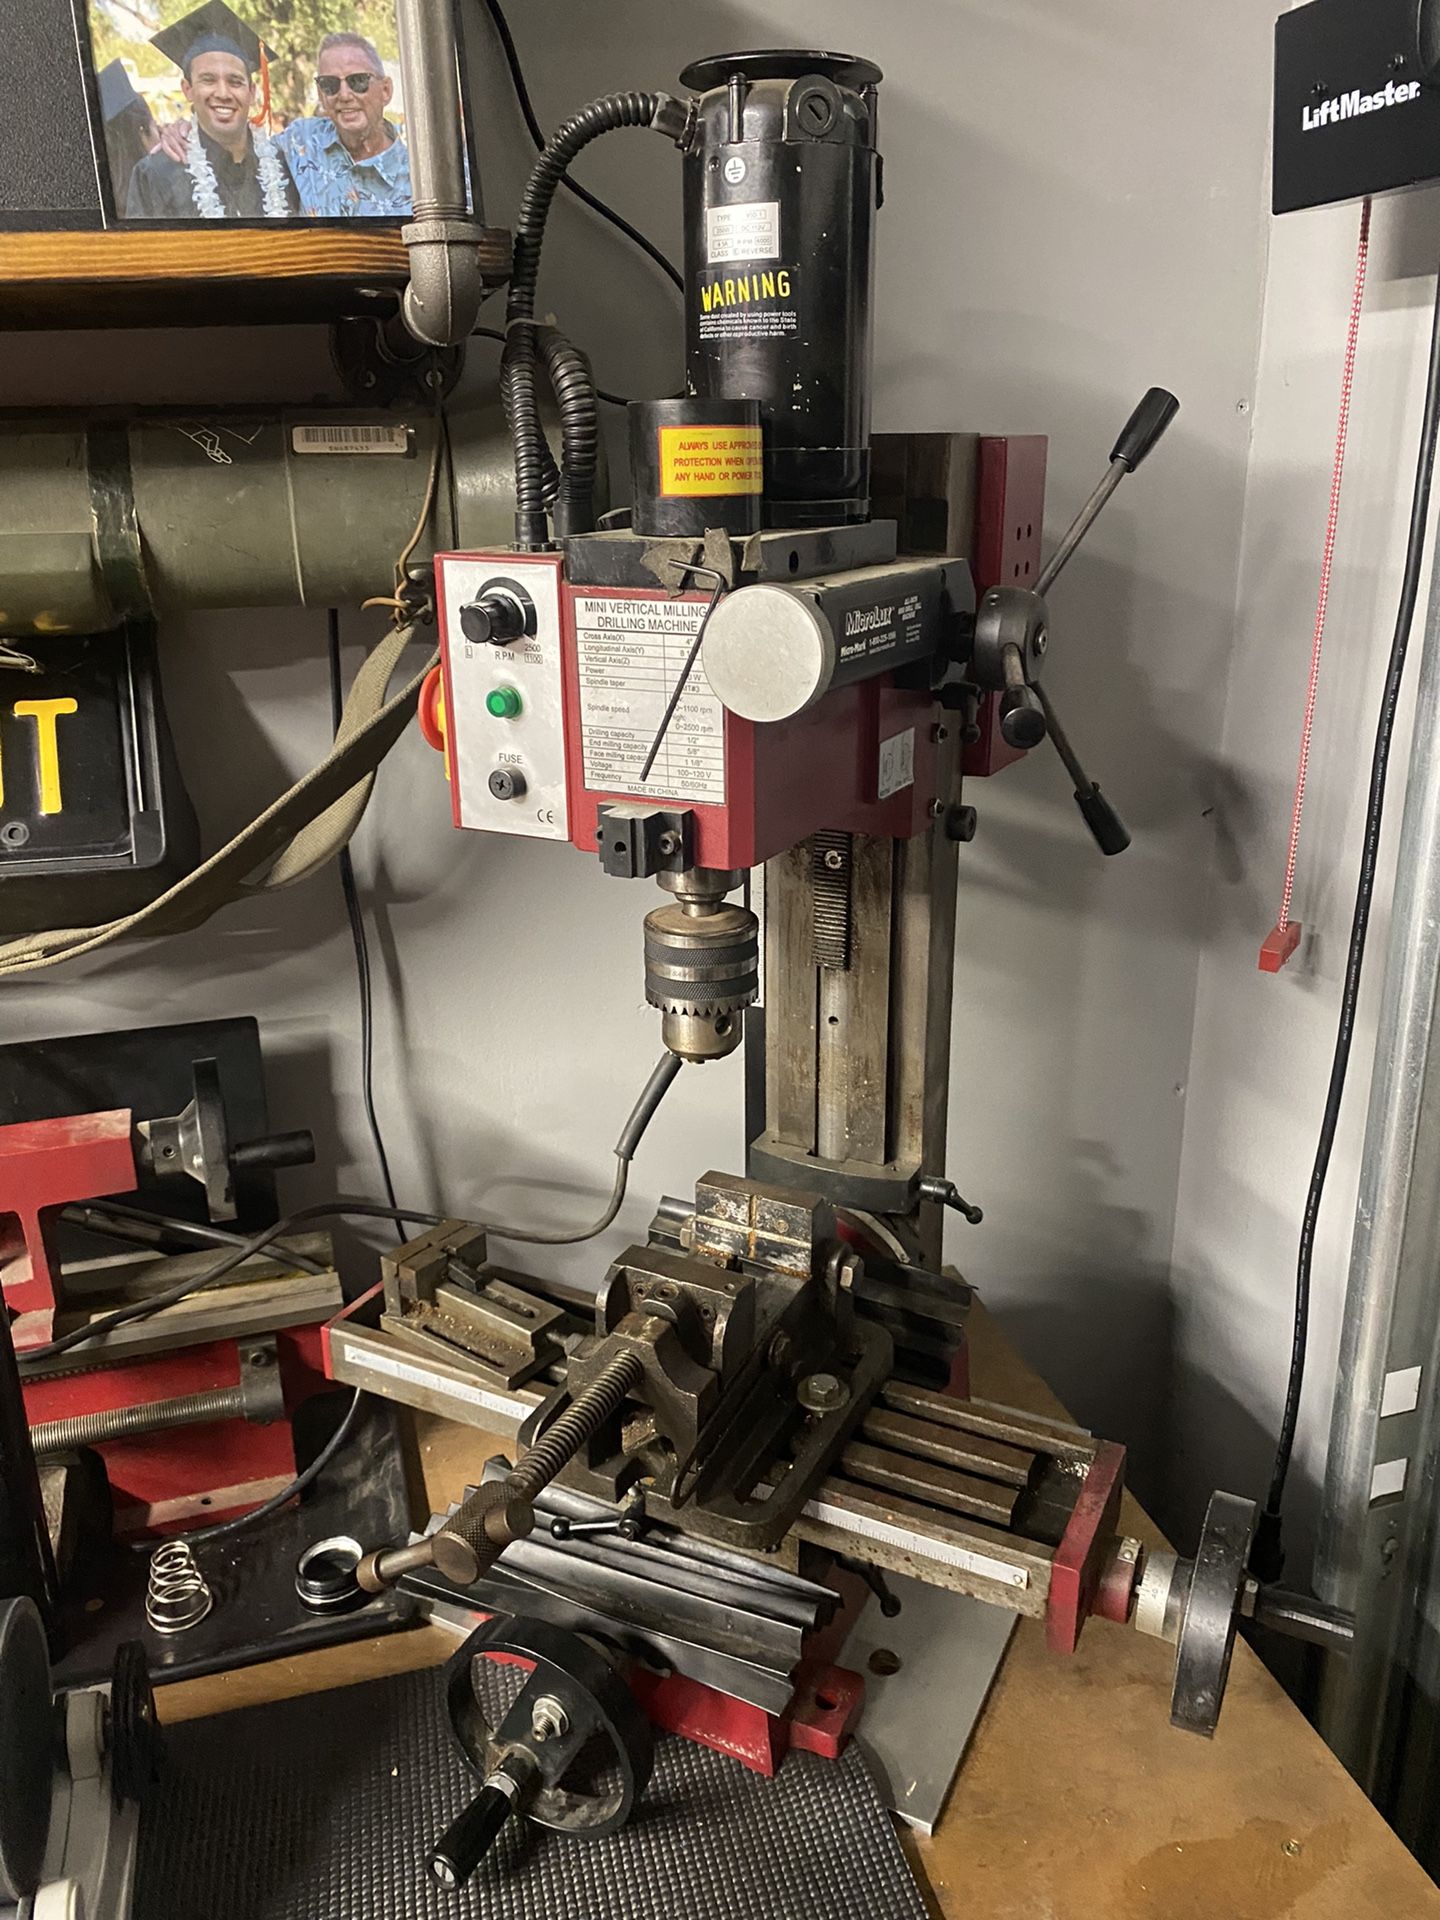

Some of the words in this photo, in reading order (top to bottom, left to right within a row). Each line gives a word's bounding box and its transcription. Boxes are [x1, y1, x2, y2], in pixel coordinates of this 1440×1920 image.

[710, 250, 729, 258] CLASS
[741, 246, 774, 255] REVERSE
[701, 270, 791, 313] WARNING
[678, 441, 709, 451] ALWAYS
[712, 440, 728, 451] USE
[673, 457, 722, 467] PROTECTION
[725, 457, 744, 466] WHEN
[674, 472, 691, 482] ANY
[693, 471, 715, 481] HAND
[718, 471, 730, 481] OR
[731, 471, 753, 480] POWER
[584, 601, 607, 613] MINI
[609, 602, 661, 616] VERTICAL
[663, 604, 707, 618] MILLING
[597, 616, 646, 630] DRILLING
[648, 618, 698, 633] MACHINE
[583, 632, 602, 640] Cross
[524, 643, 541, 652] 2500
[584, 643, 621, 653] Longitudinal
[622, 645, 645, 655] Axis(Y)
[584, 654, 607, 663] Vertical
[608, 656, 631, 666] Axis(Z)
[585, 666, 605, 674] Power
[585, 677, 609, 686] Spindle
[609, 679, 626, 687] taper
[587, 703, 610, 712] Spindle
[611, 706, 630, 714] speed
[700, 706, 713, 714] rpm
[588, 728, 609, 738] Drilling
[610, 730, 635, 739] capacity
[701, 726, 714, 734] rpm
[588, 739, 602, 747] End
[602, 740, 622, 750] milling
[622, 742, 648, 751] capacity
[498, 752, 524, 764] FUSE
[589, 749, 605, 757] Face
[605, 751, 625, 761] milling
[589, 760, 613, 771] Voltage
[590, 771, 622, 782] Frequency
[705, 771, 712, 779] V
[627, 785, 647, 793] MADE
[656, 788, 679, 797] CHINA
